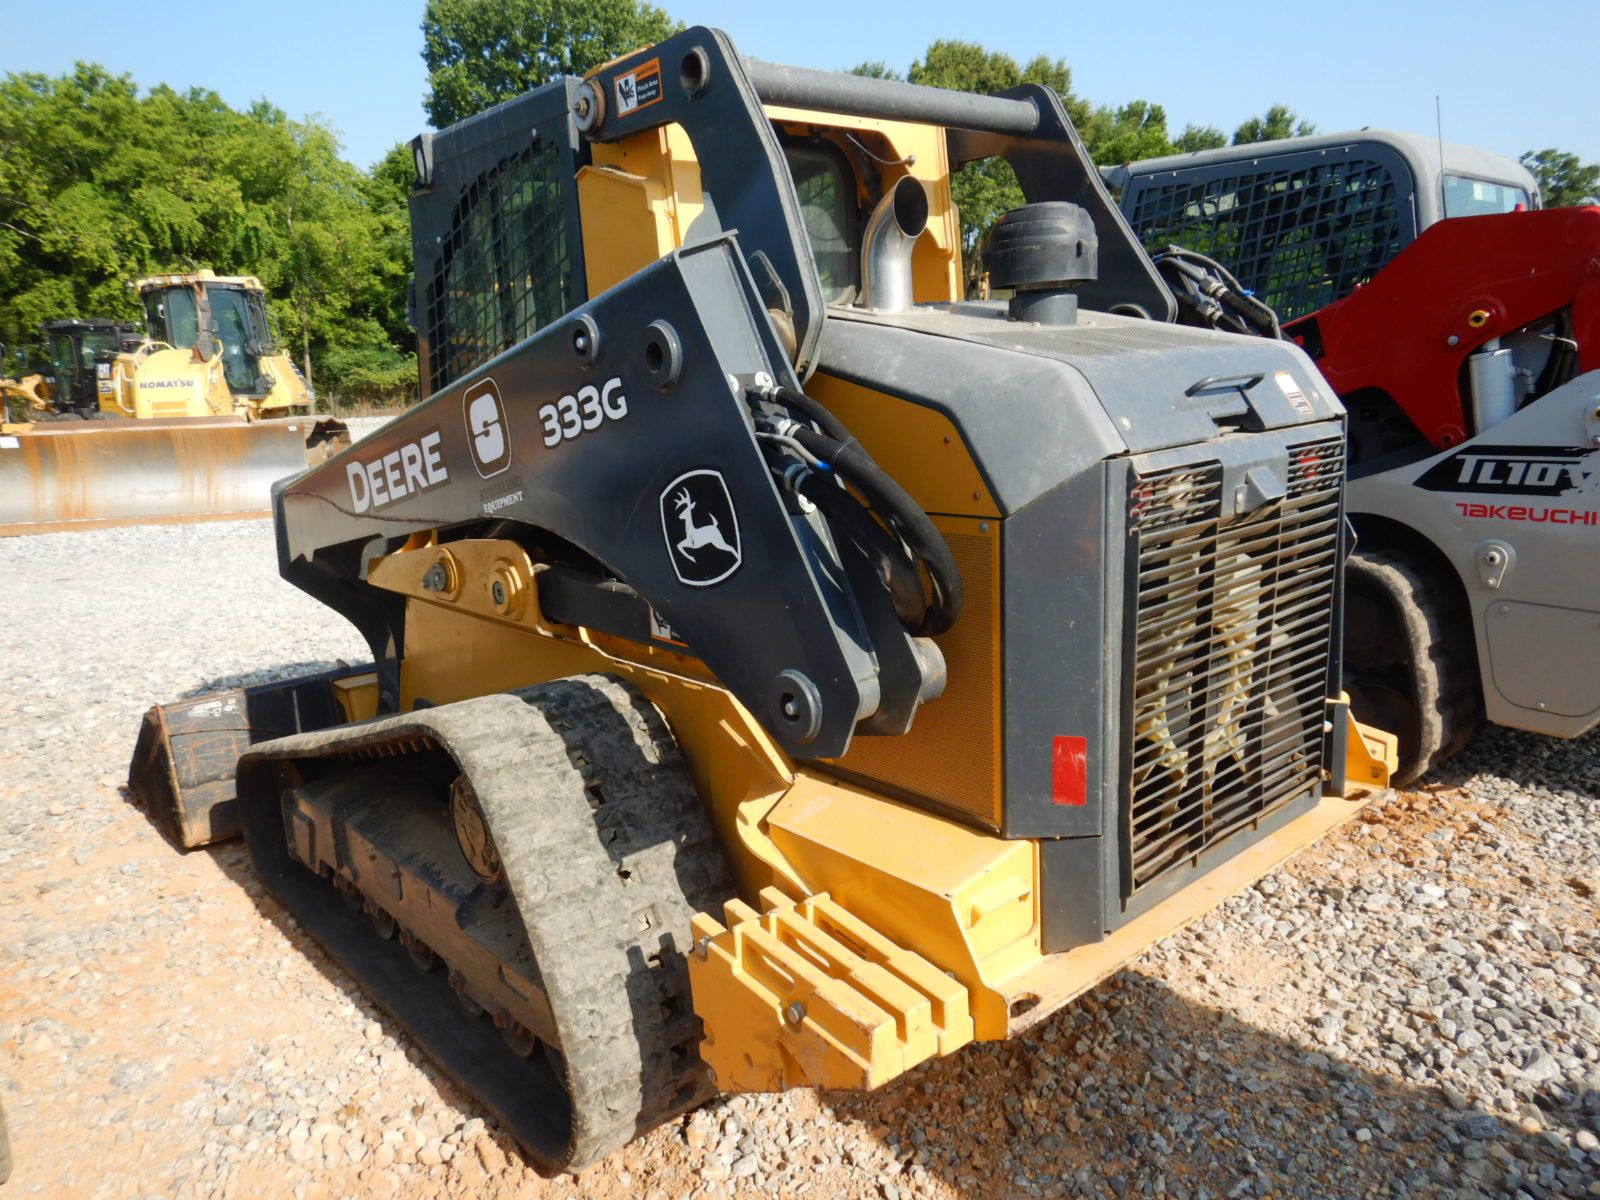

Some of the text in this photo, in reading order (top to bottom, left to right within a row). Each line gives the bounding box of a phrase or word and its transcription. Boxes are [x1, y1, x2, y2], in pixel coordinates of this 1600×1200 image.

[139, 380, 195, 389] KOMATSU
[538, 377, 628, 447] 333G
[346, 431, 448, 513] DEERE
[483, 491, 524, 514] EQUIPMENT
